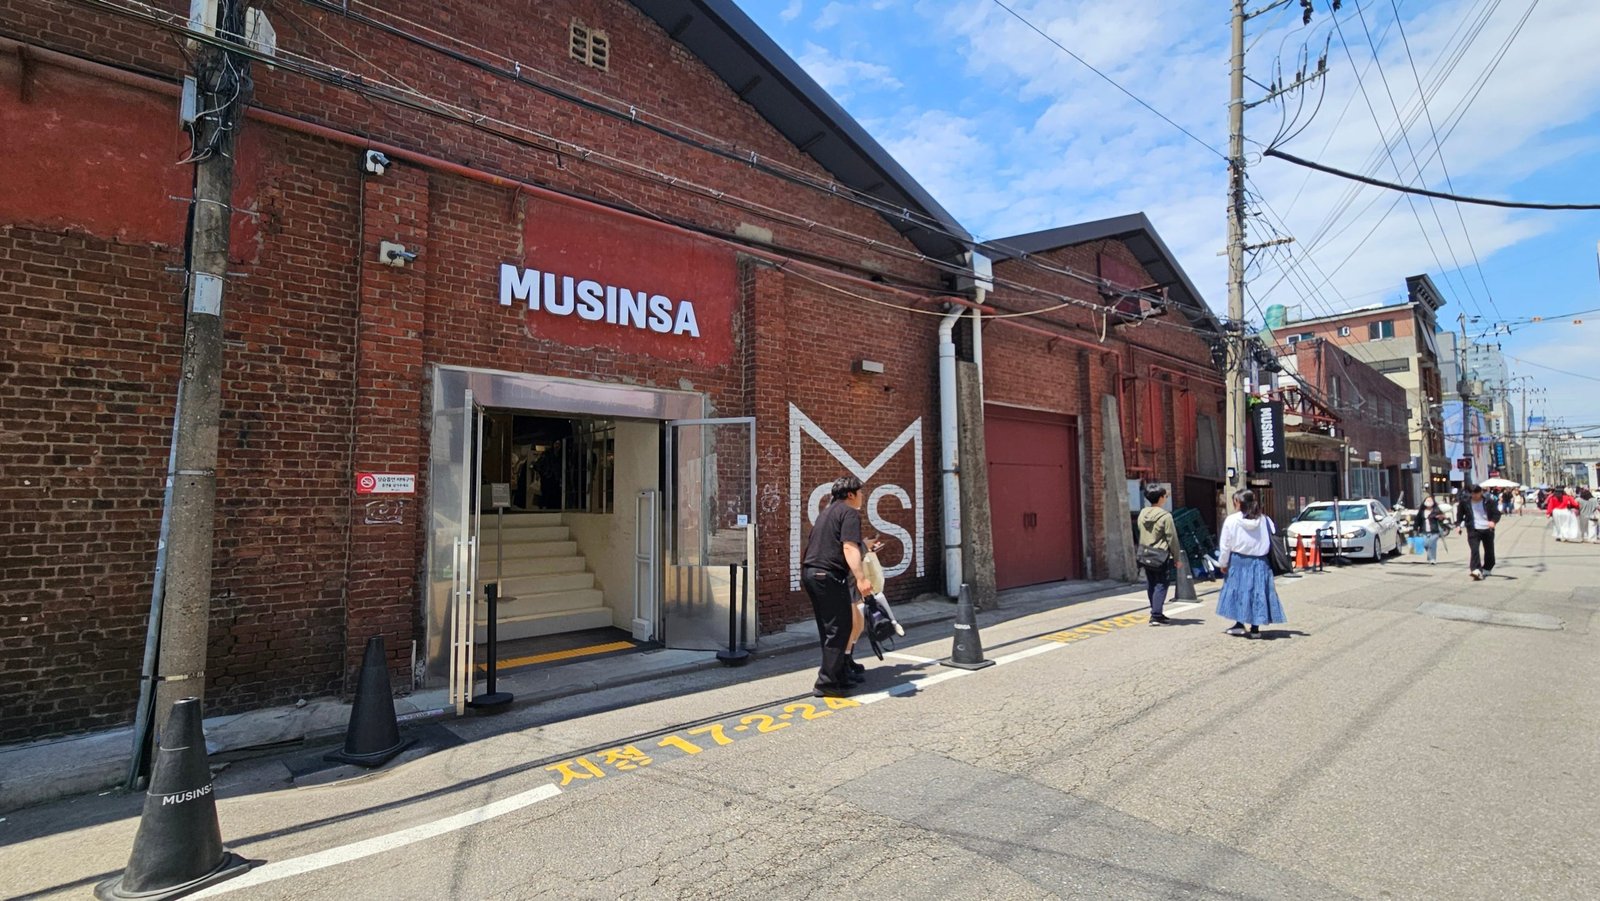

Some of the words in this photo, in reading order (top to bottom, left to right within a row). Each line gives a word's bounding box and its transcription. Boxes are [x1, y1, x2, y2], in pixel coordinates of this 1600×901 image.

[500, 263, 700, 337] MUSINSA
[1260, 407, 1275, 455] MUSINSA
[545, 745, 652, 786] 지정
